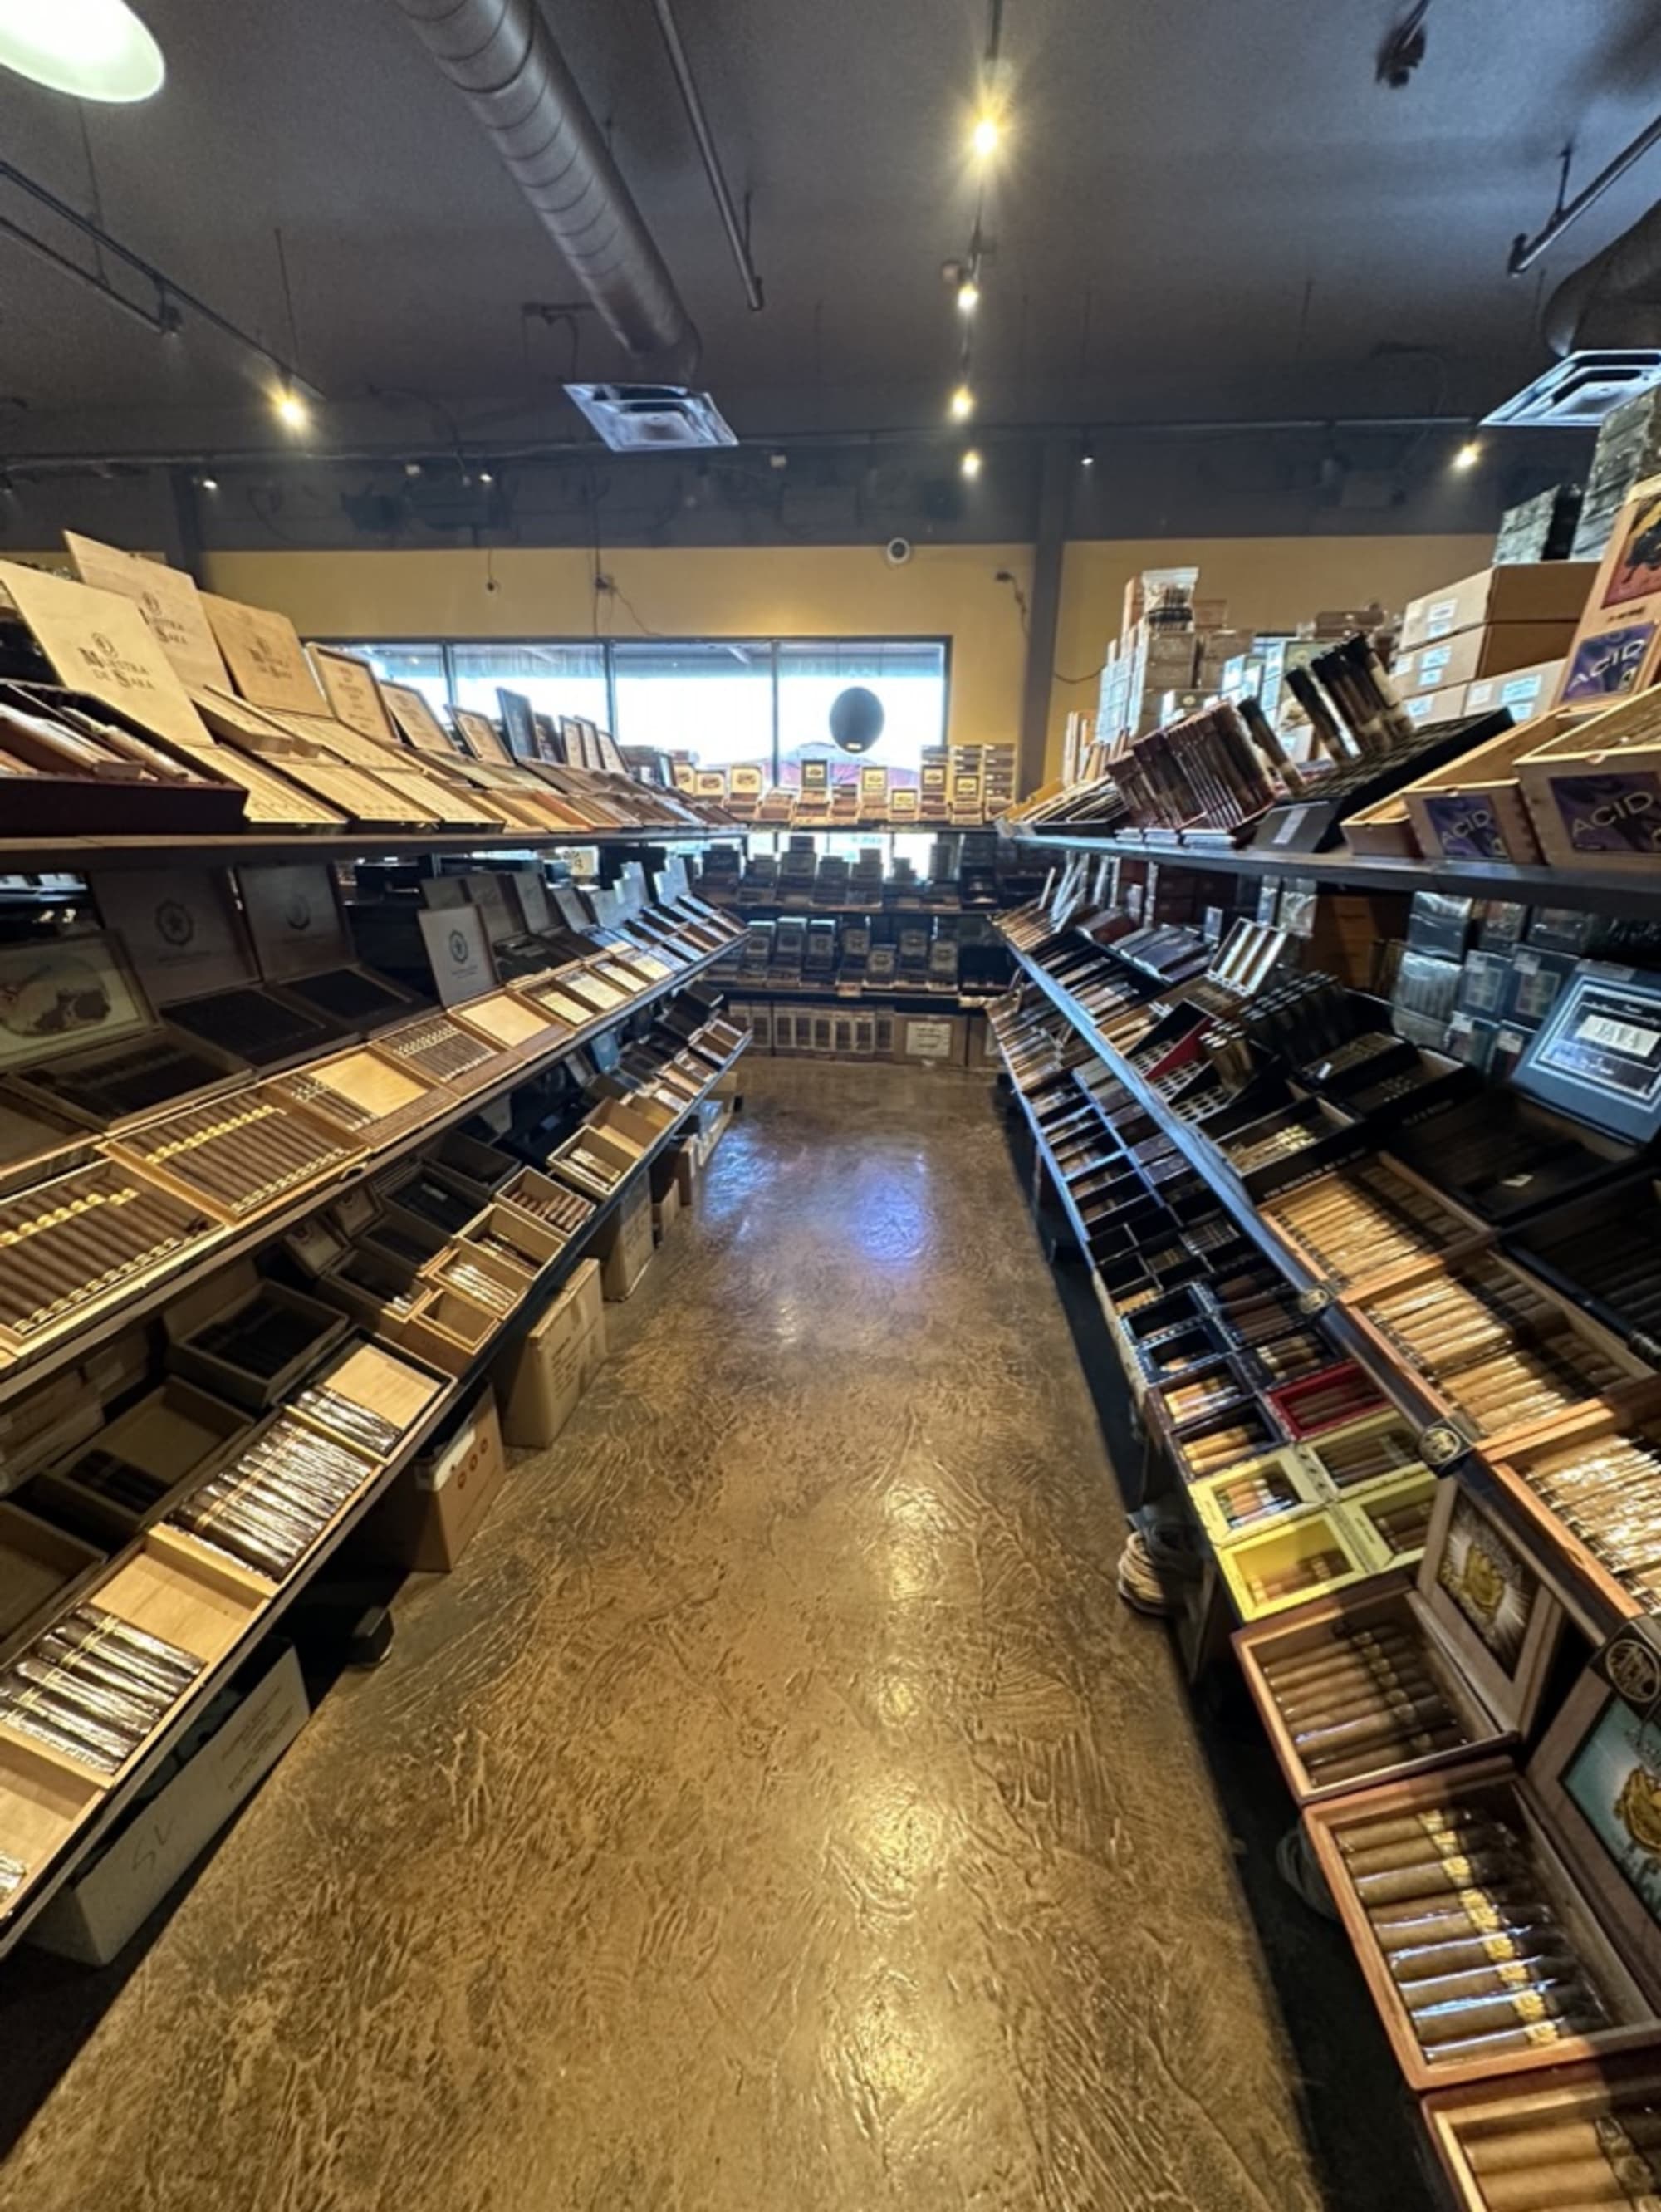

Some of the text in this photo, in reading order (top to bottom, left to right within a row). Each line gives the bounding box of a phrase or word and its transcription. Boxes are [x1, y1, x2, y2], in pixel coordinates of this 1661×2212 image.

[1567, 638, 1646, 693] ACID
[1440, 809, 1492, 846] ACID
[1571, 791, 1654, 838] ACID
